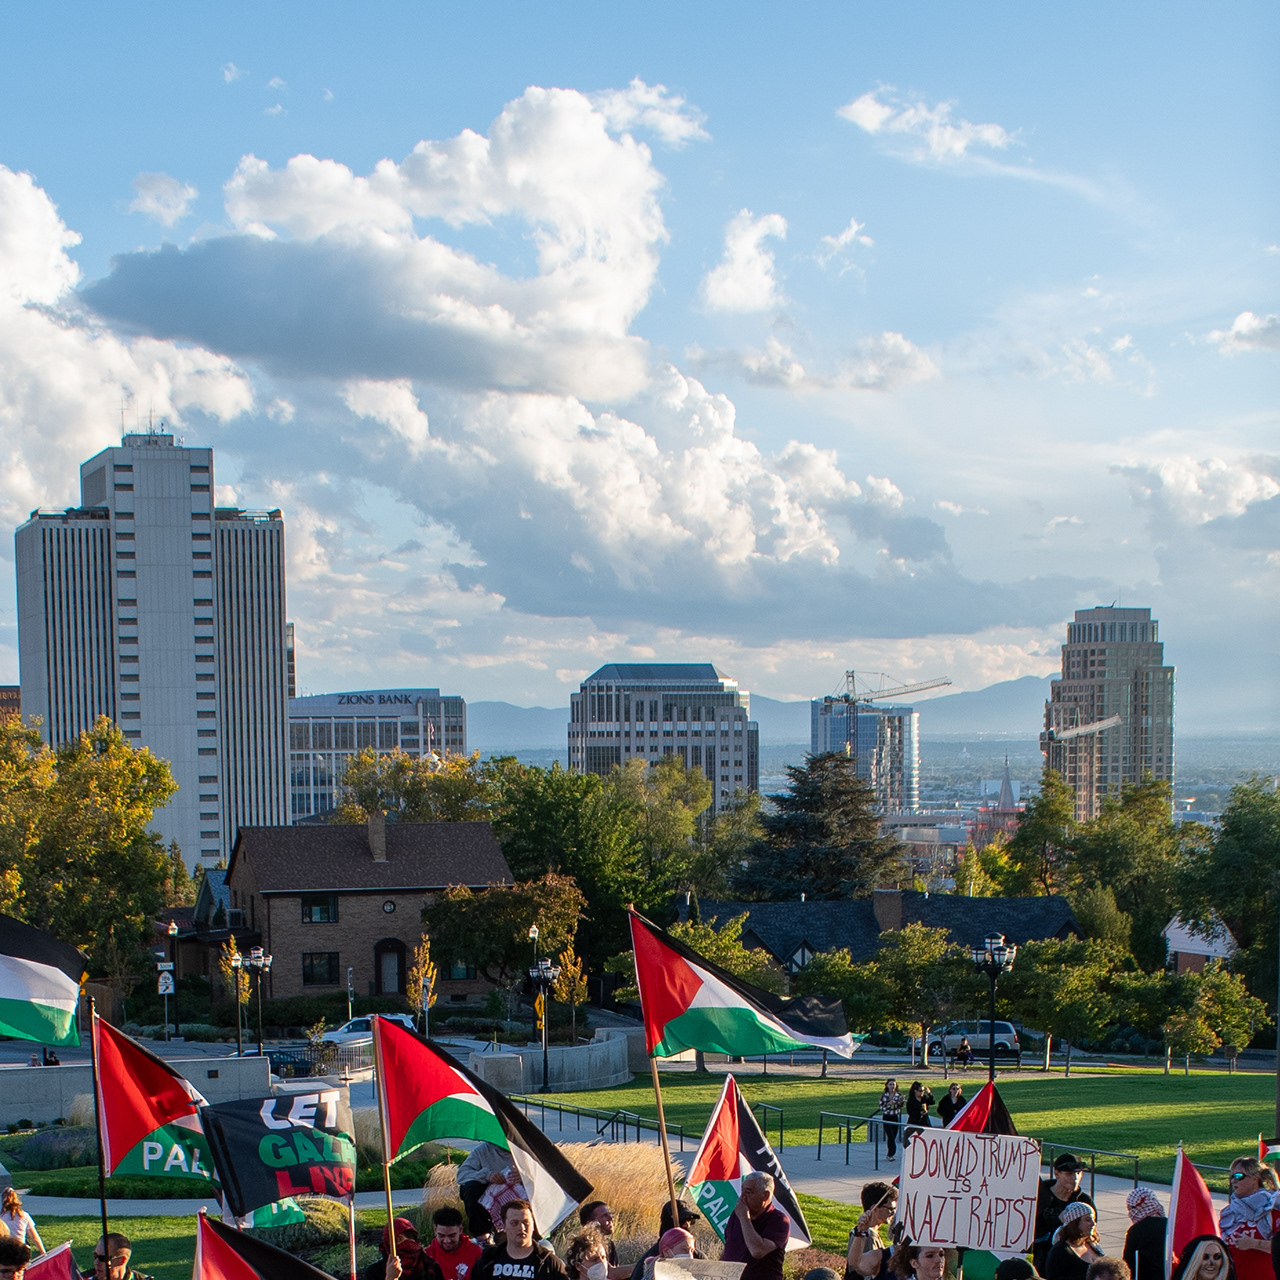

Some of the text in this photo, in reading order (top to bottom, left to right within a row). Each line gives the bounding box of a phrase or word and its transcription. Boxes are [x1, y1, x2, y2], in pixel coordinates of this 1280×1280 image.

[337, 695, 413, 705] ZIONS BANK
[260, 1091, 341, 1130] LET
[258, 1131, 356, 1168] GAZA
[910, 1134, 1040, 1182] DONALD TRUMP
[947, 1176, 988, 1196] IS A
[900, 1191, 1036, 1250] NAZI RAPIST
